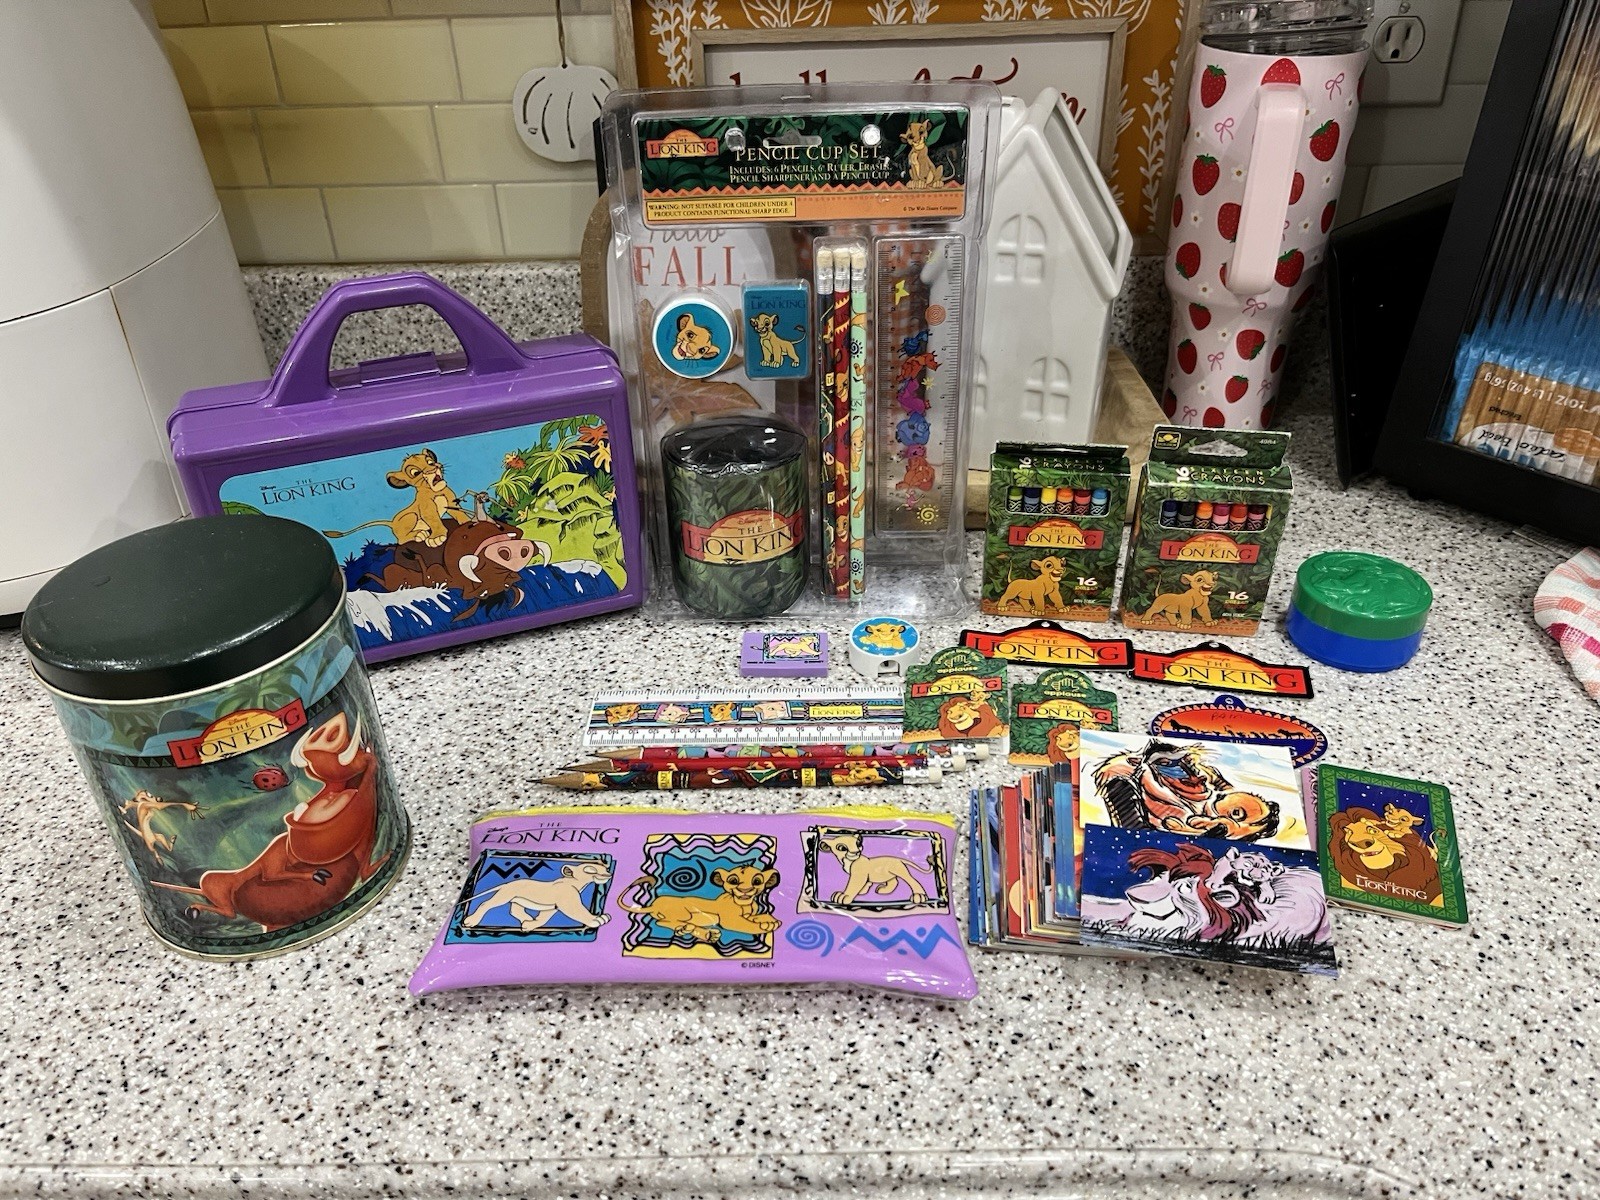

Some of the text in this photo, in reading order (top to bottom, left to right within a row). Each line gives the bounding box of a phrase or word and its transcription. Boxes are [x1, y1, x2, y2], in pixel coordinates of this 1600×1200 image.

[650, 141, 716, 155] LION KING
[736, 143, 882, 161] PENCIL CUP SET
[774, 165, 779, 173] 6
[730, 170, 890, 184] PENCIL SHARPENER AND A PENCIL CUP
[633, 246, 746, 288] FALL
[1018, 456, 1032, 470] 16
[1176, 466, 1266, 486] 16 CRAYONS
[262, 476, 356, 505] LION KING
[738, 526, 763, 536] THE
[1016, 530, 1096, 546] LION KING
[688, 530, 744, 557] LION
[1168, 545, 1252, 560] LION KING
[1076, 576, 1098, 586] 16
[1228, 591, 1250, 600] 16
[974, 638, 1037, 657] LION
[1047, 646, 1120, 661] KING
[936, 666, 978, 674] applause
[1142, 658, 1298, 688] LION KING
[916, 680, 998, 694] LION KING
[1044, 690, 1087, 698] applause
[836, 708, 861, 716] KING
[1023, 706, 1108, 721] LION KING
[177, 708, 300, 761] LION KING
[229, 722, 251, 734] THE
[480, 828, 620, 844] LION KING
[1356, 878, 1428, 900] LION KING
